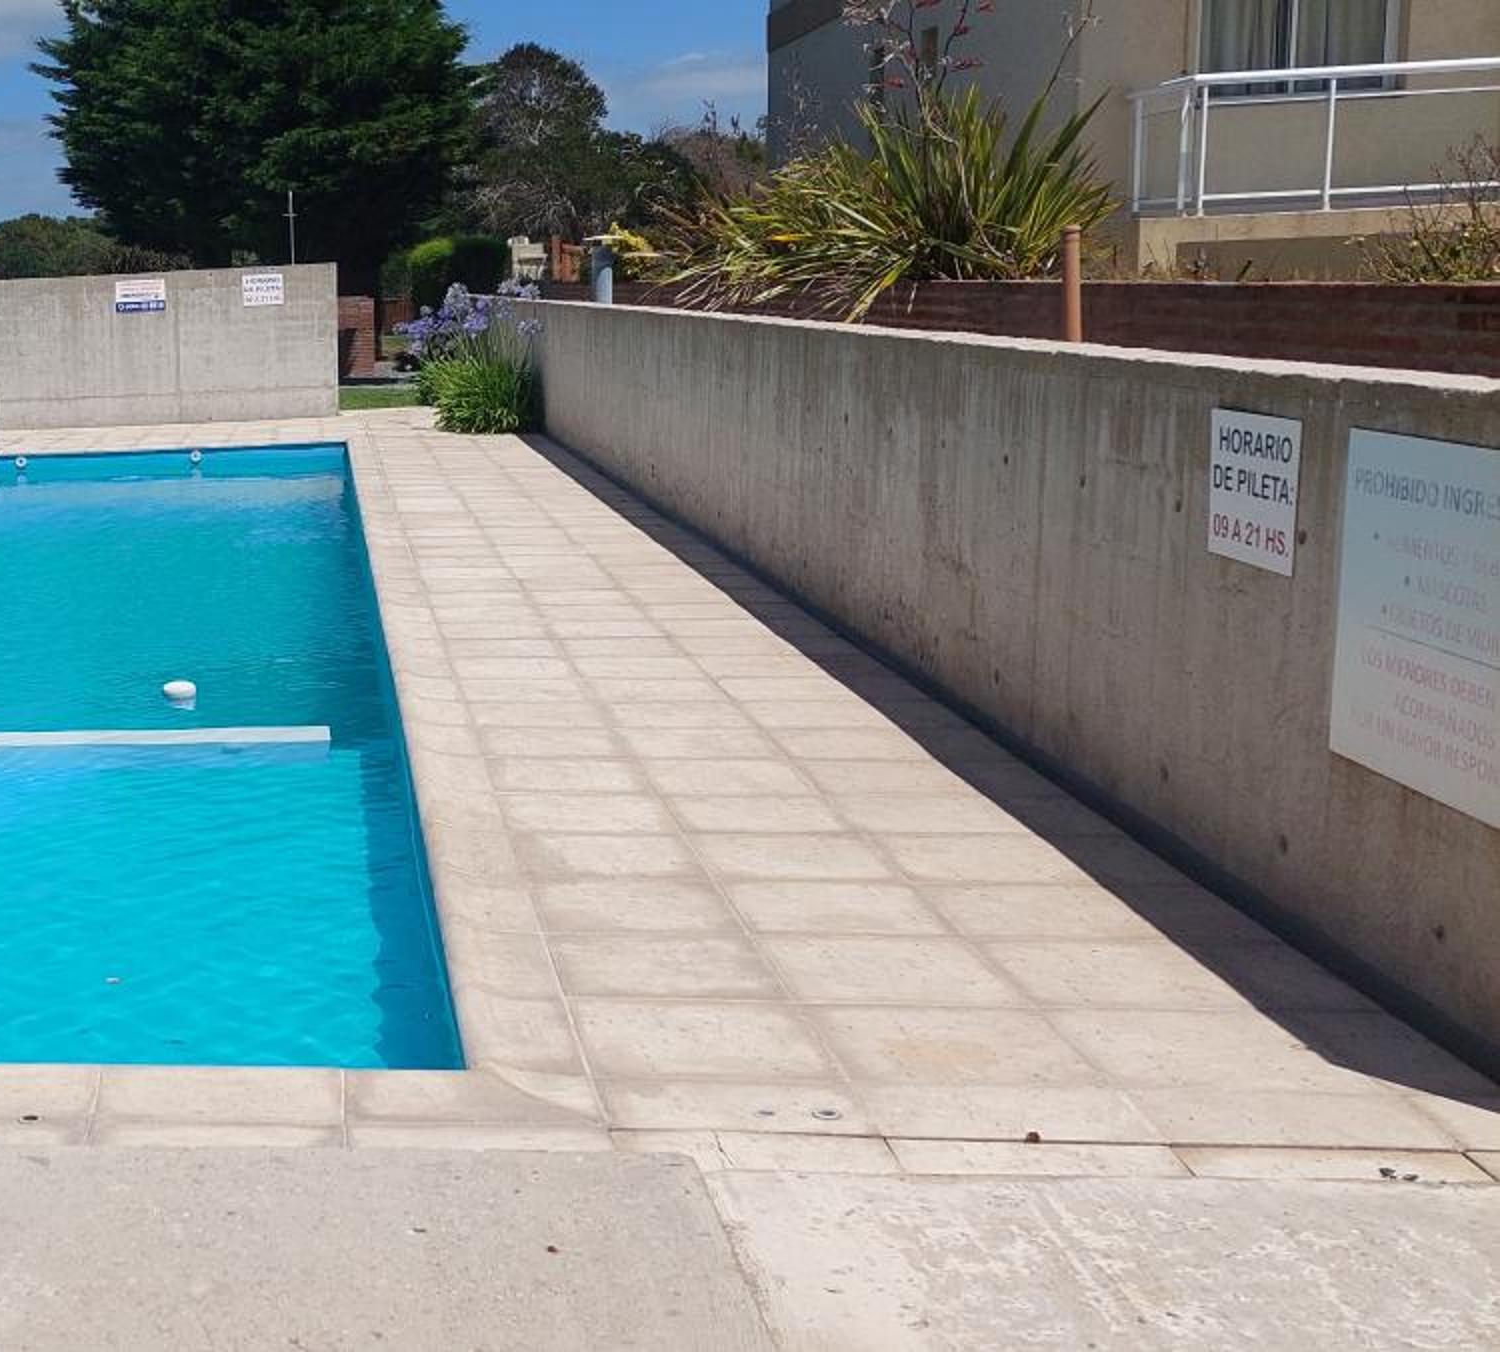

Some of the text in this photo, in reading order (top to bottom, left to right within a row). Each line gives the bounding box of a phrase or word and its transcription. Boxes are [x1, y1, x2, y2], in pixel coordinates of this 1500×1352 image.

[1219, 425, 1293, 463] HORARIO
[1213, 464, 1233, 491] DE
[1354, 467, 1440, 508] PROHIBIDO
[1213, 513, 1290, 557] 09 A 21 HS.
